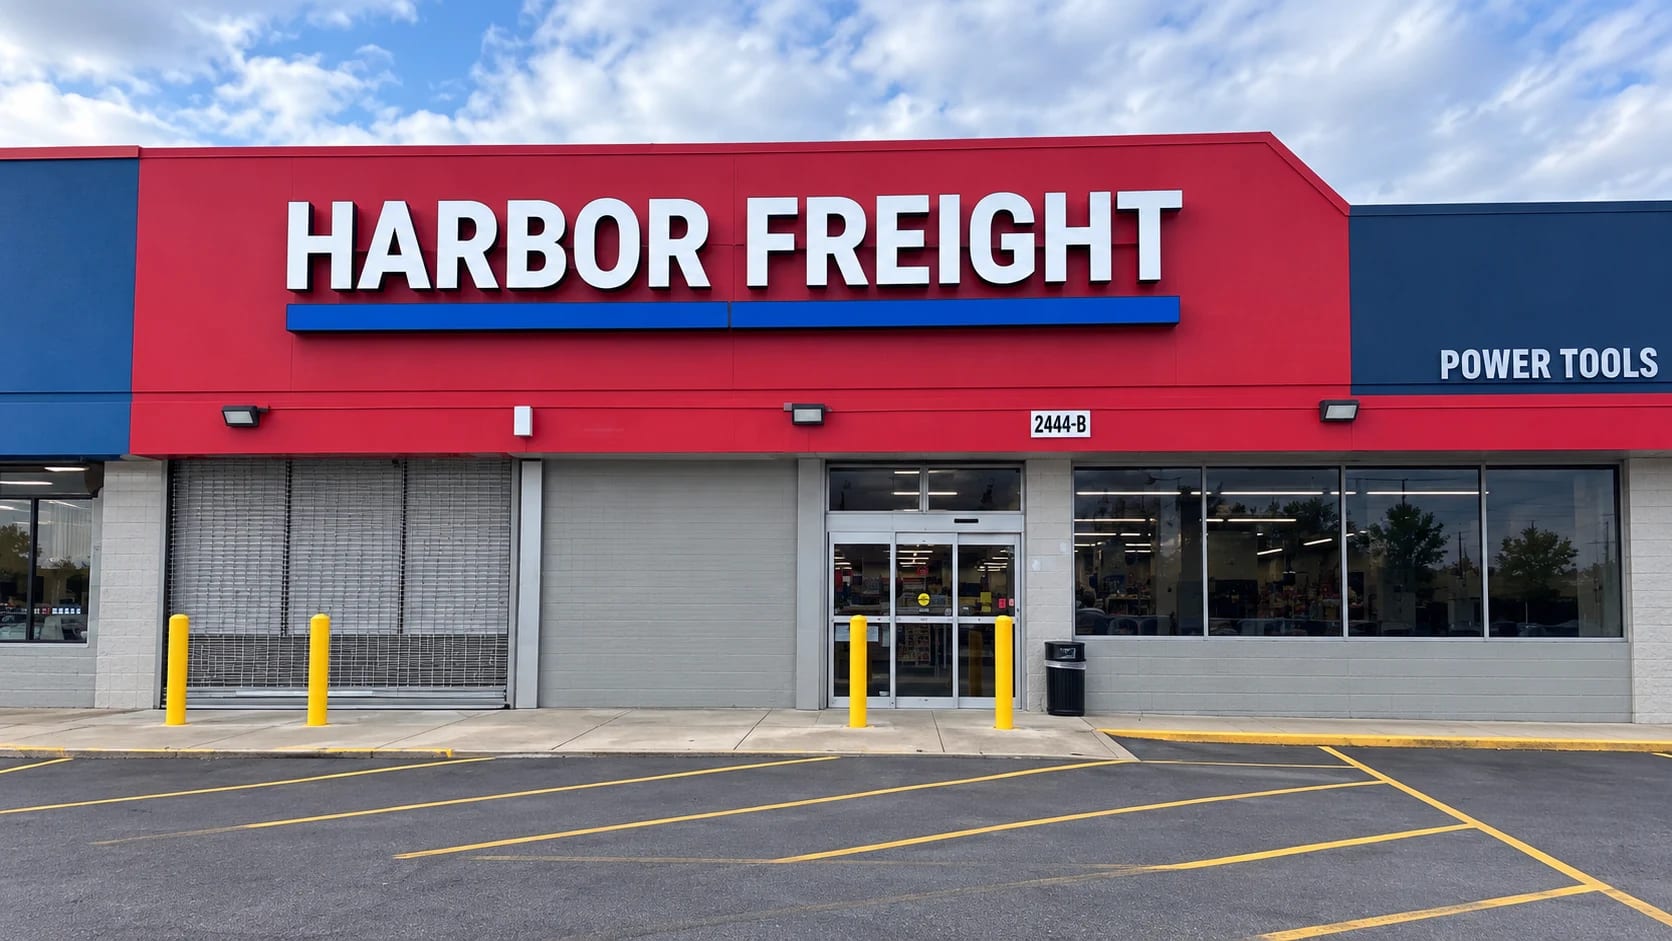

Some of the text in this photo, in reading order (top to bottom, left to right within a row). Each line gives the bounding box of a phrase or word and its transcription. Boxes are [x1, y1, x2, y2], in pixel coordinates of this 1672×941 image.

[286, 190, 1183, 290] HARBOR FREIGHT
[1440, 347, 1659, 380] POWER TOOLS
[1034, 414, 1087, 433] 2444-B
